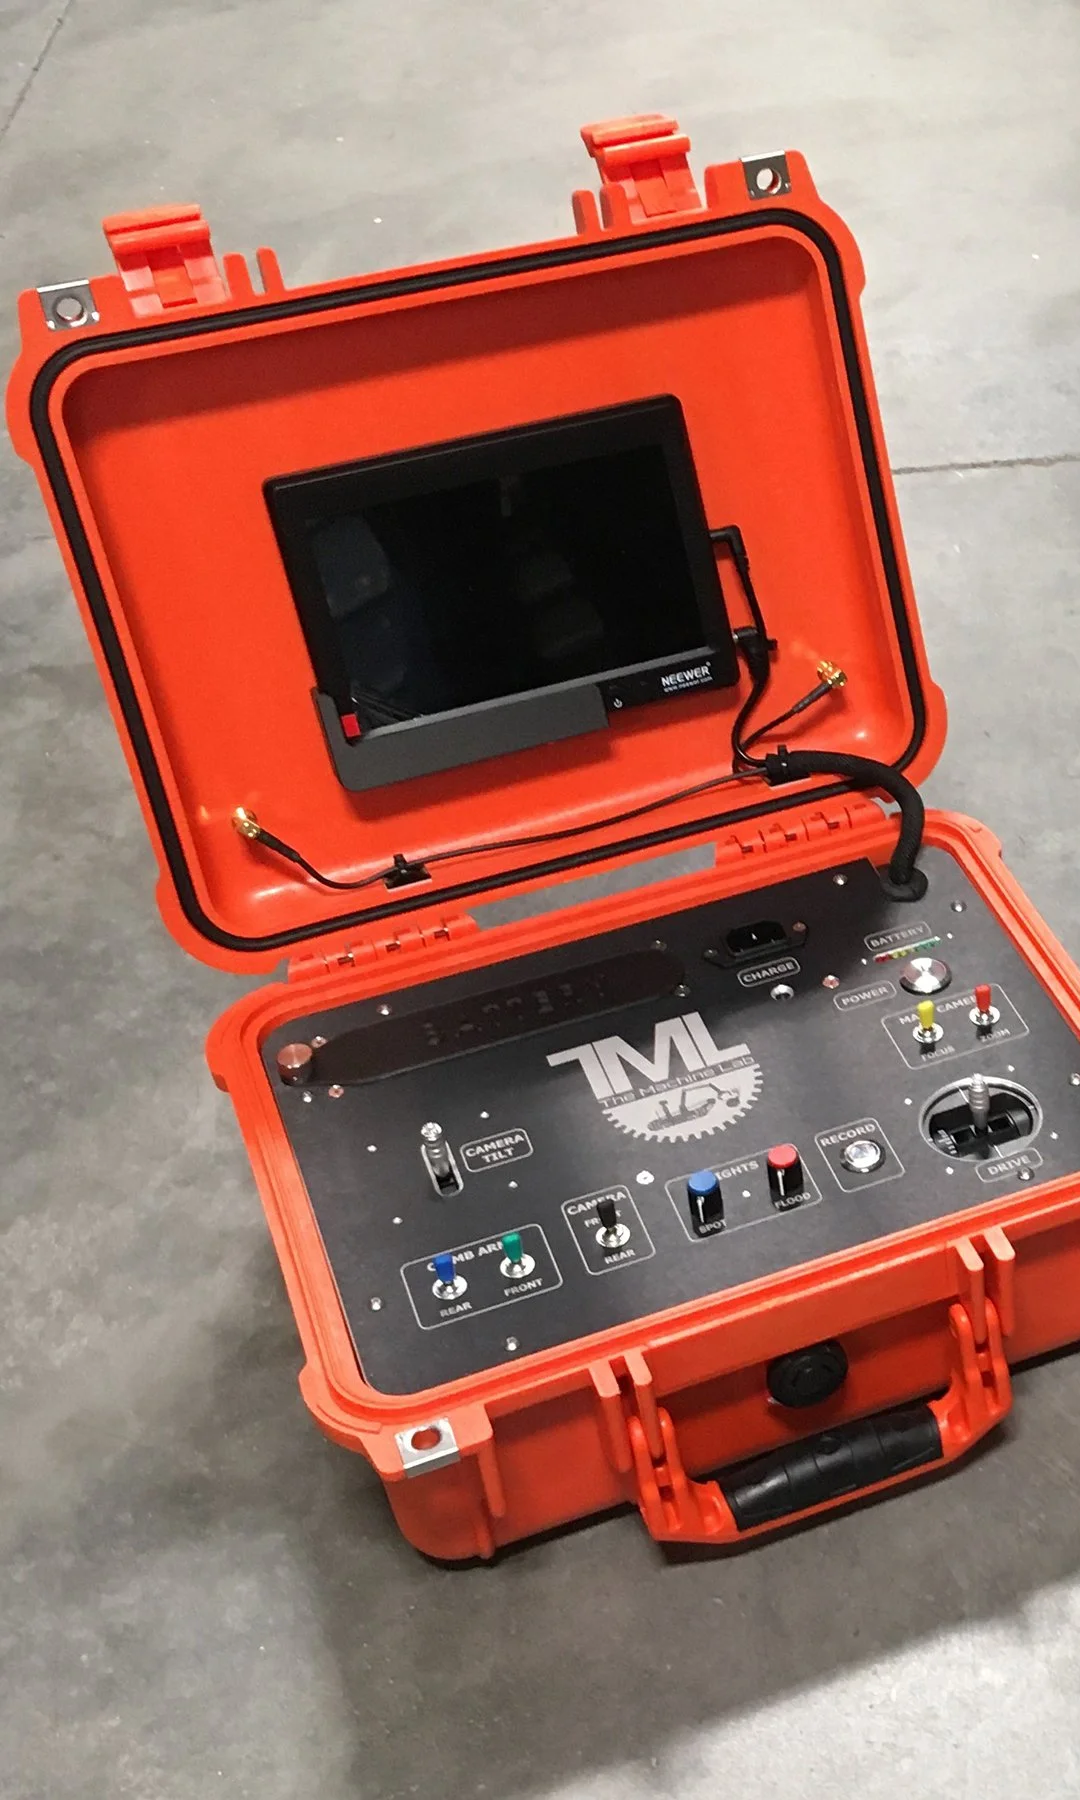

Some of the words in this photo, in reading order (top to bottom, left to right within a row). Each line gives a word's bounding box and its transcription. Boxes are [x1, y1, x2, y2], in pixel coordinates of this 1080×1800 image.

[661, 665, 711, 687] NEEWER
[870, 926, 924, 948] BATTERY
[743, 961, 795, 982] CHARGE
[841, 986, 888, 1006] POWER
[980, 1028, 1011, 1043] ZOOM
[546, 1011, 751, 1100] TML
[920, 1044, 956, 1062] FOCUS
[600, 1089, 637, 1108] The
[639, 1067, 716, 1097] Machine
[717, 1053, 755, 1074] Lab
[820, 1123, 876, 1147] RECORD
[465, 1134, 525, 1157] CAMERA
[481, 1146, 514, 1163] TILT
[715, 1160, 760, 1181] IGHTS
[987, 1155, 1031, 1175] DRIVE
[774, 1192, 812, 1209] FLOOD
[699, 1219, 727, 1234] SPOT
[427, 1250, 475, 1271] CMB
[604, 1249, 636, 1265] REAR
[503, 1278, 543, 1296] FRONT
[440, 1302, 473, 1318] REAR
